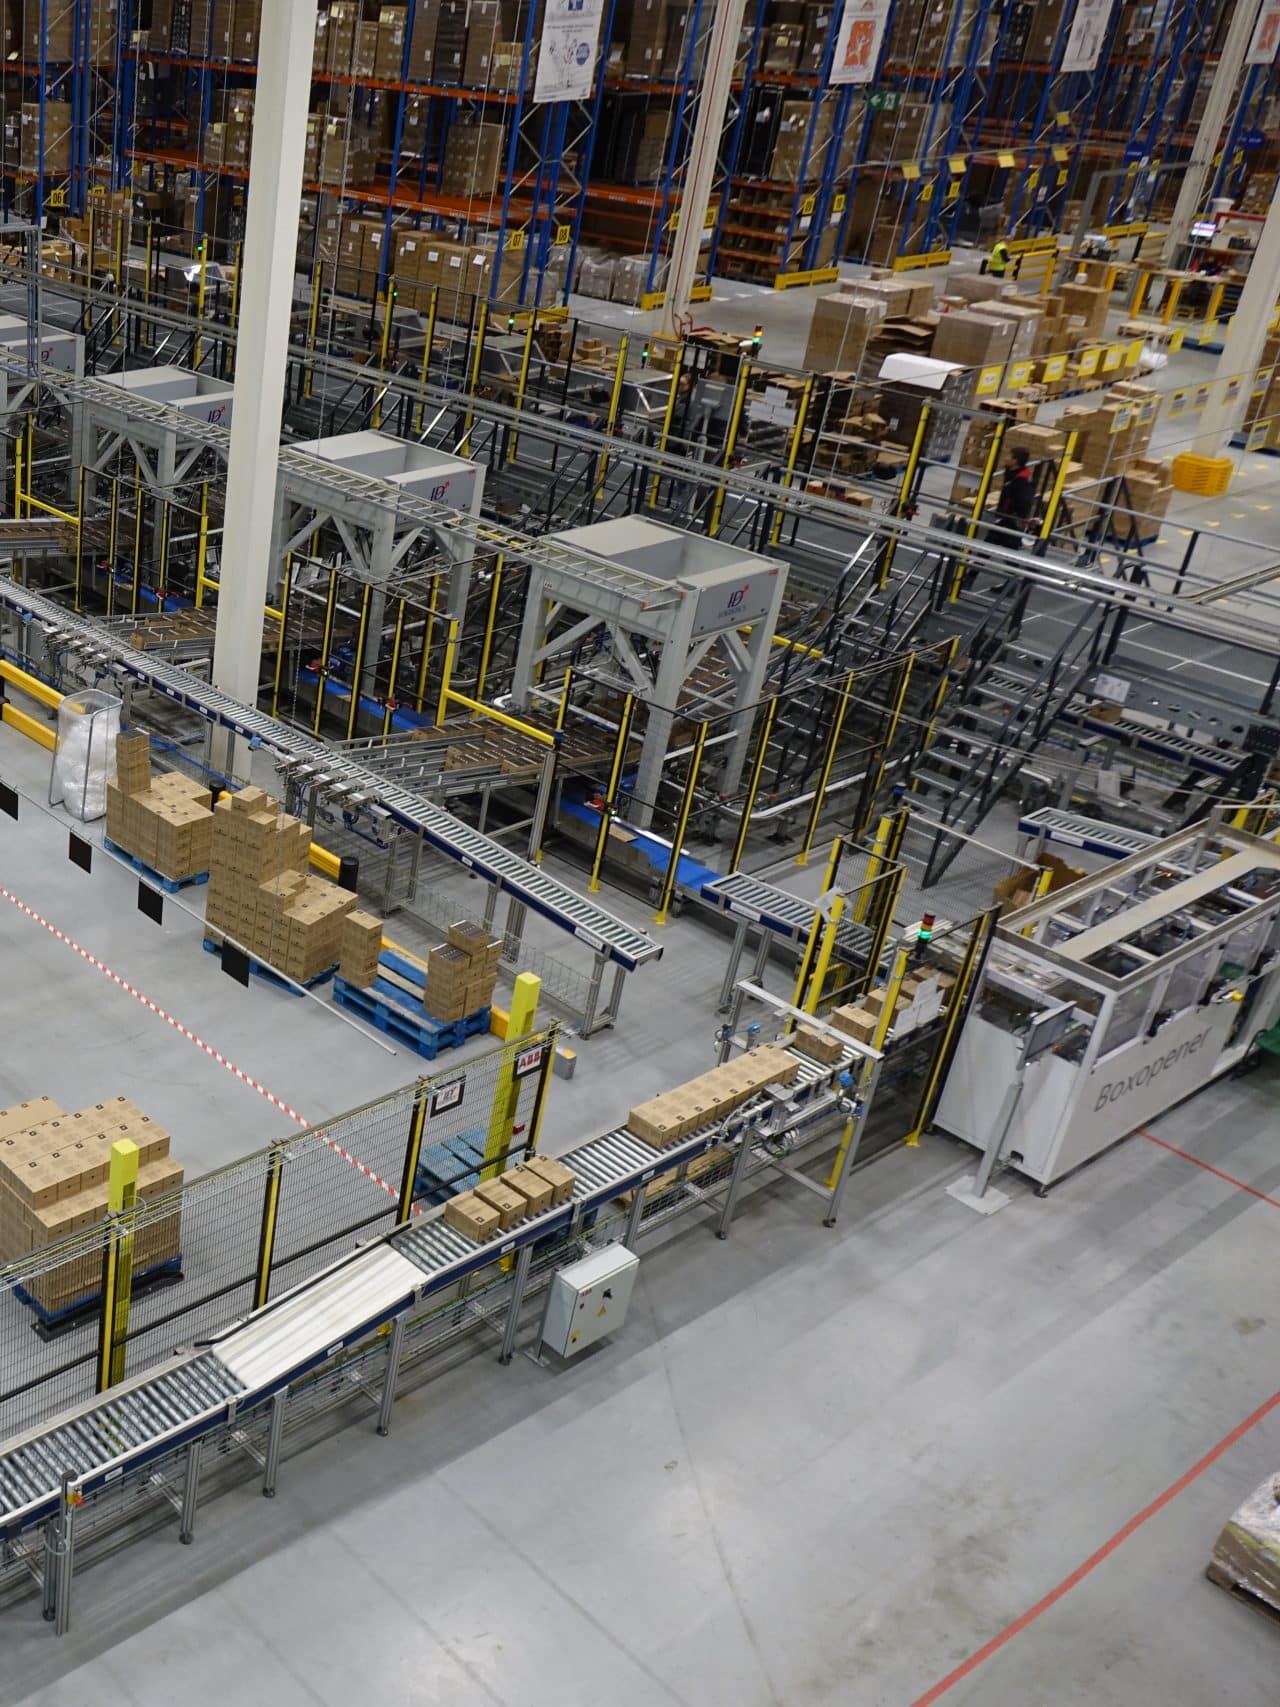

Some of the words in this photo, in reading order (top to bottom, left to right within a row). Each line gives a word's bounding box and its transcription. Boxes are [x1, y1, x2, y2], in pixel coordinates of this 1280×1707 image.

[430, 485, 445, 501] ID
[727, 590, 744, 608] ID
[519, 1050, 540, 1069] ABB
[1093, 1024, 1214, 1112] Boxopener
